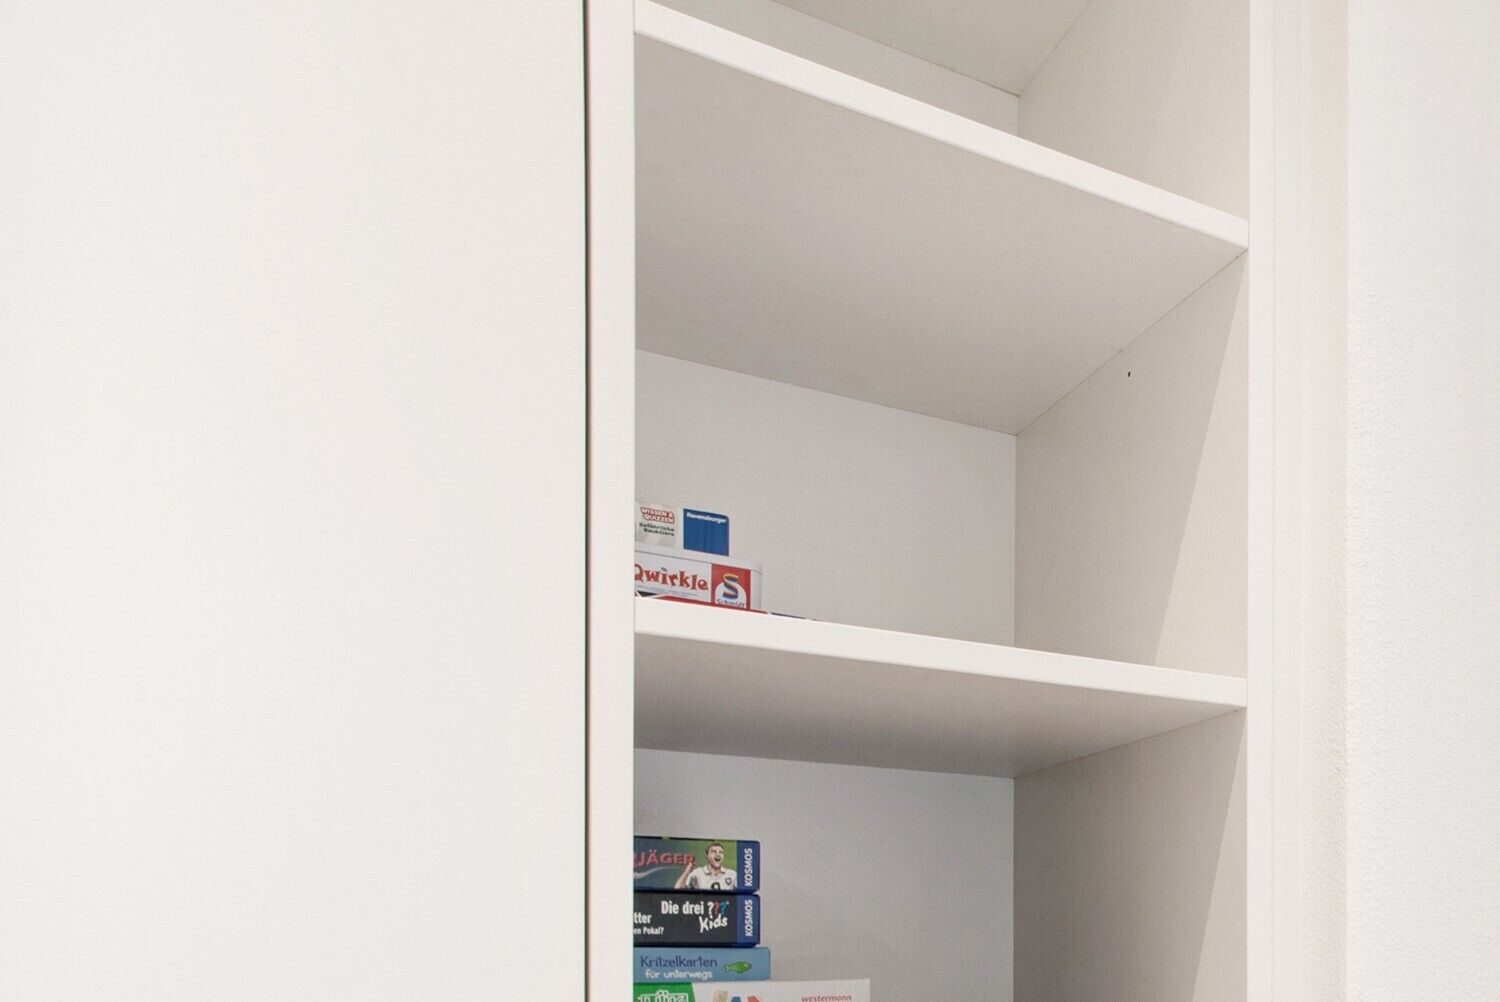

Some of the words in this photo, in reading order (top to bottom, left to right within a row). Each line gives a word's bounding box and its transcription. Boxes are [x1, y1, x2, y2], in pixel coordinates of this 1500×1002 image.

[686, 511, 727, 524] Ravensburger
[744, 847, 753, 887] KOSMOS
[661, 900, 680, 915] Die
[682, 901, 704, 915] drei
[699, 913, 728, 933] Kids
[744, 899, 753, 937] KOSMOS
[642, 926, 664, 935] Pokal?
[640, 954, 718, 968] Kritzelkarten
[663, 969, 713, 980] unterwegs
[801, 994, 852, 1002] westermann
